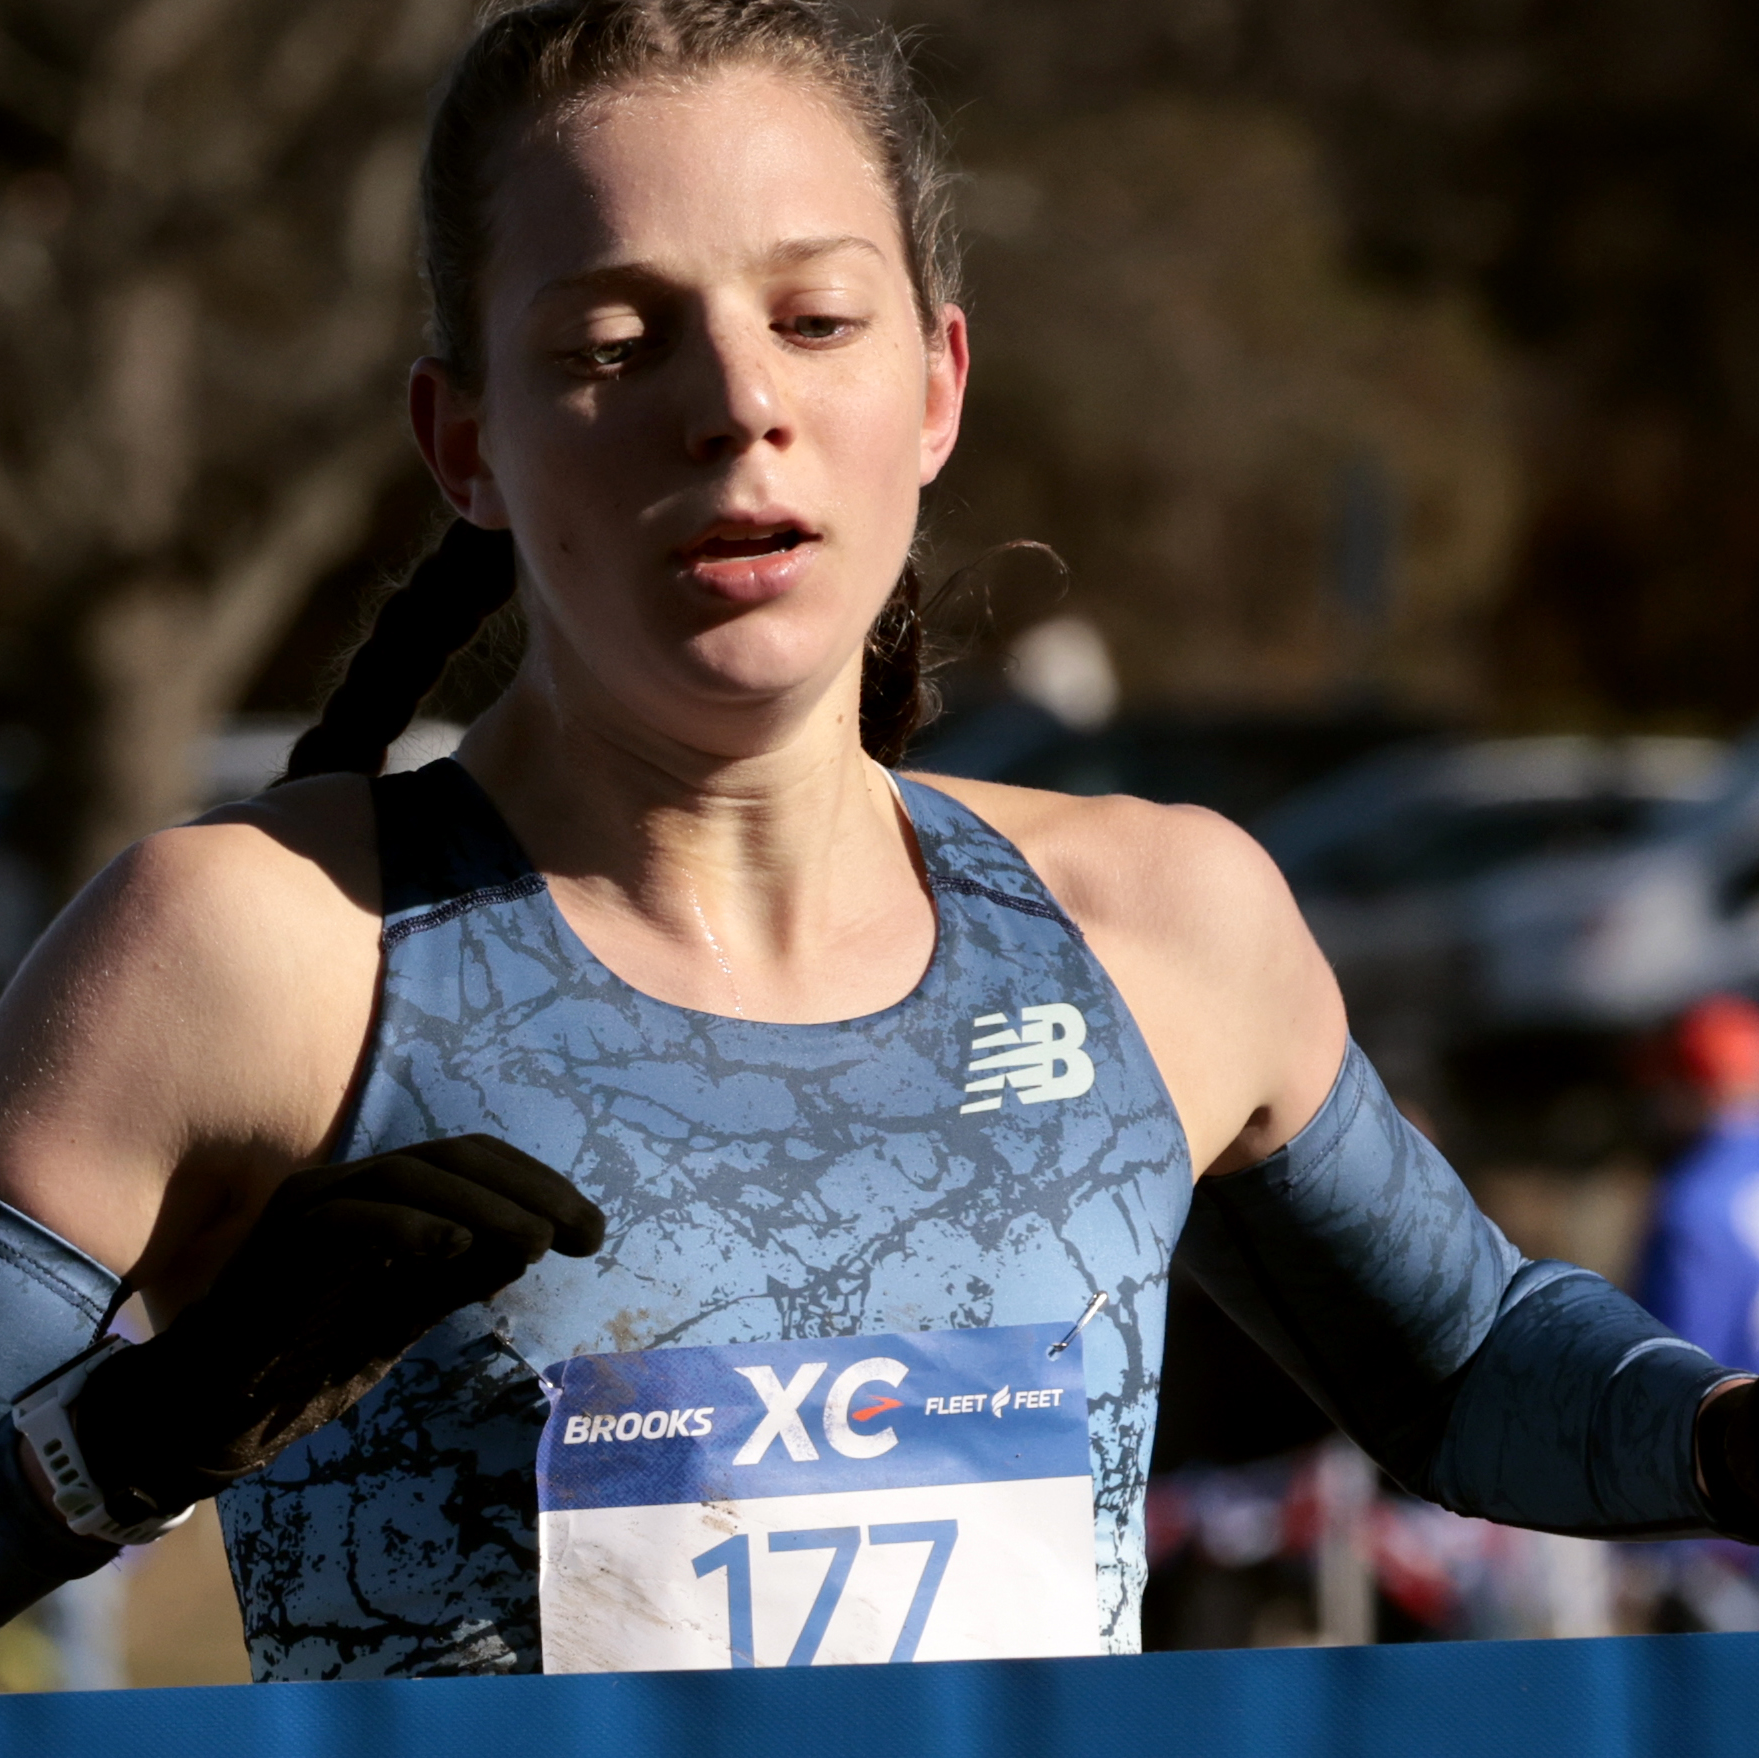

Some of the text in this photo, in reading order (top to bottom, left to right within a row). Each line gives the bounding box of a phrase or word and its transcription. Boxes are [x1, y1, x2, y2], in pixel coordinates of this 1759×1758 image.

[563, 1357, 1063, 1466] BROOKS XC FLEET FEET
[691, 1519, 959, 1670] 177
